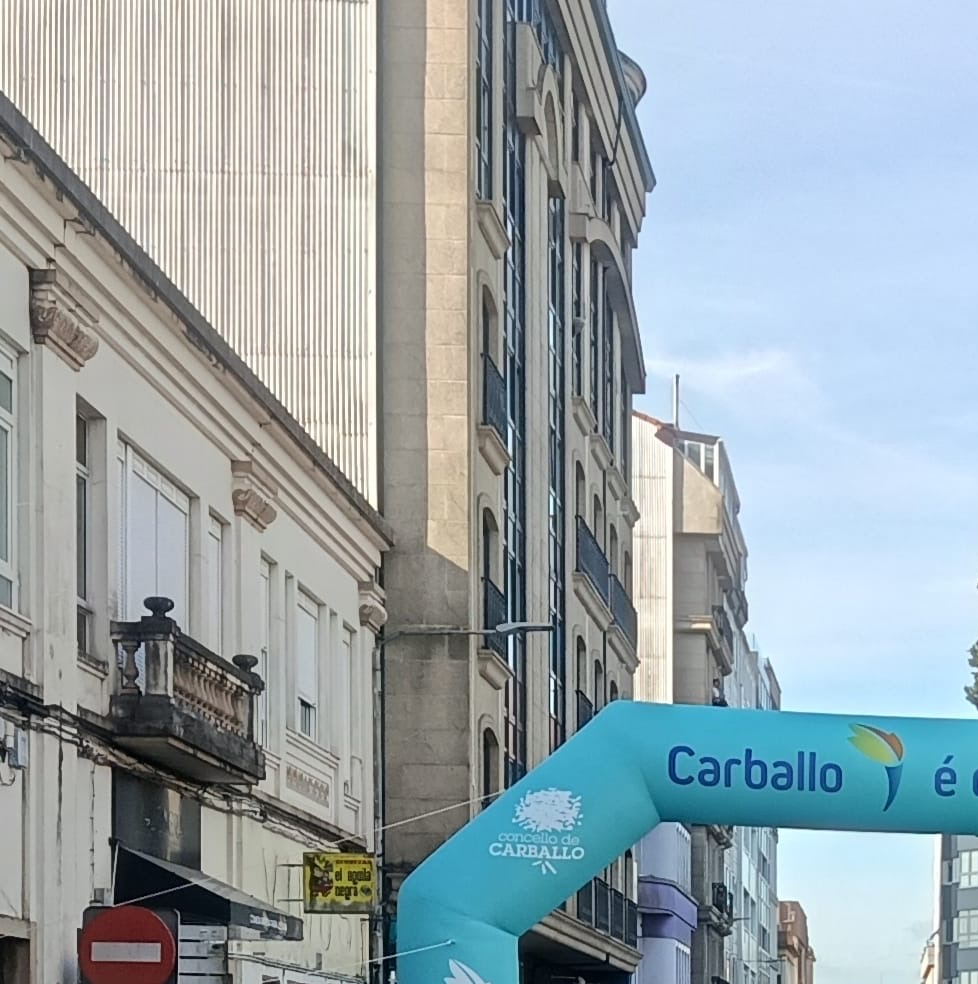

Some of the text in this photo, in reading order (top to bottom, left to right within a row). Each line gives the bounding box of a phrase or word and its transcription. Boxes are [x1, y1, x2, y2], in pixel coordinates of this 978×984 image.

[667, 745, 843, 793] Carballo
[933, 755, 958, 797] é
[498, 832, 580, 846] concello de
[489, 842, 585, 860] CARBALLO
